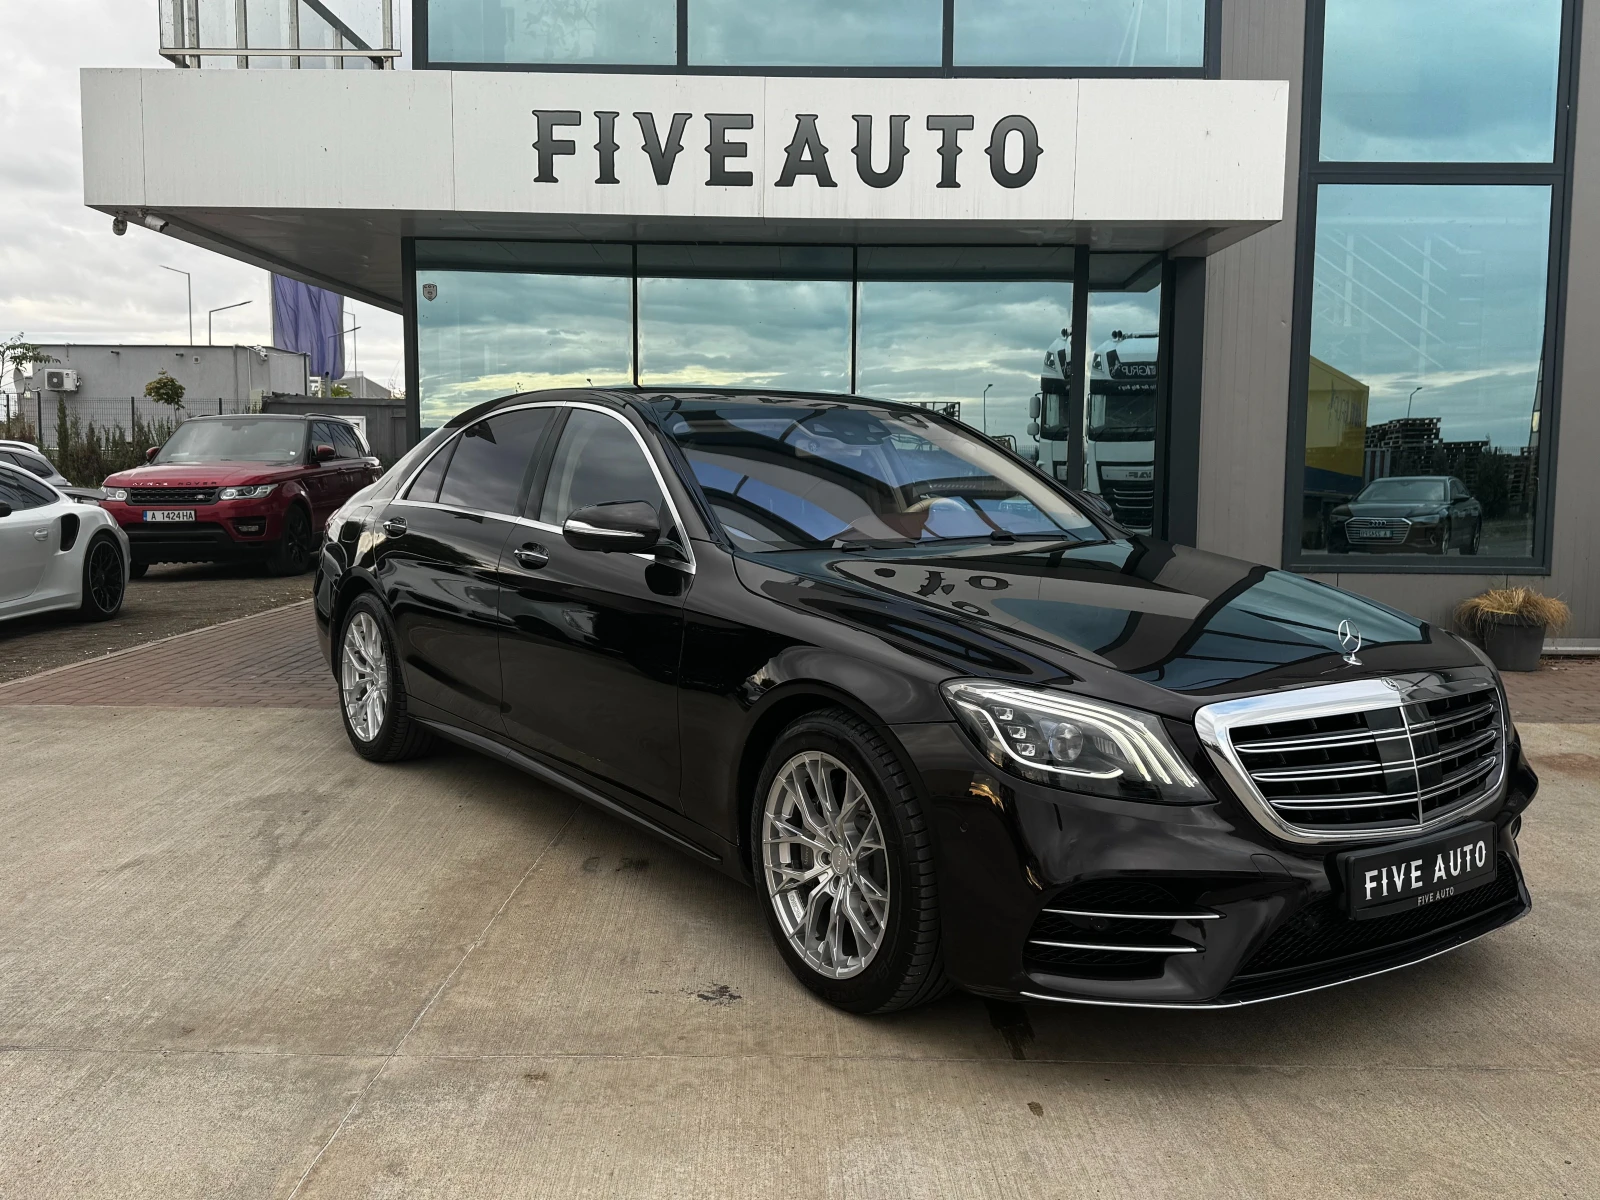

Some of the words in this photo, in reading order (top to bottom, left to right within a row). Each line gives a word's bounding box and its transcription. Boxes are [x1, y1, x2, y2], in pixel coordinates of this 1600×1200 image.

[151, 511, 157, 521] A
[1364, 858, 1423, 900] FIVE
[1432, 840, 1487, 884] AUTO
[1417, 892, 1434, 906] FIVE
[1435, 886, 1455, 901] AUTO
